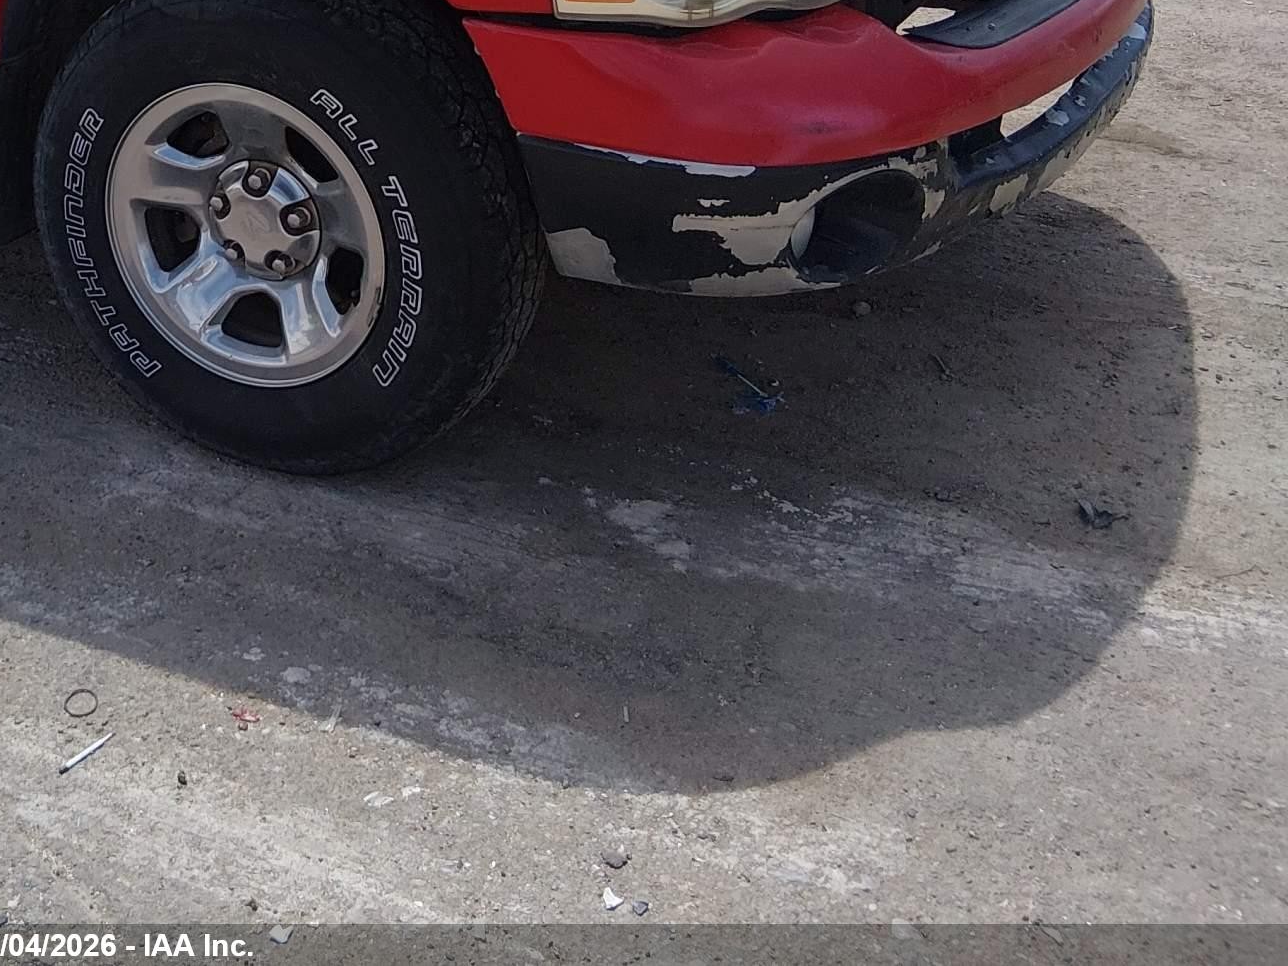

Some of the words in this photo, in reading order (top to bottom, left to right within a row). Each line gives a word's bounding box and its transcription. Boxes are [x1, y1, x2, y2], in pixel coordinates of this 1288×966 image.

[63, 108, 162, 379] PATHFINDER
[310, 88, 382, 166] ALL
[372, 175, 423, 388] TERRAIN
